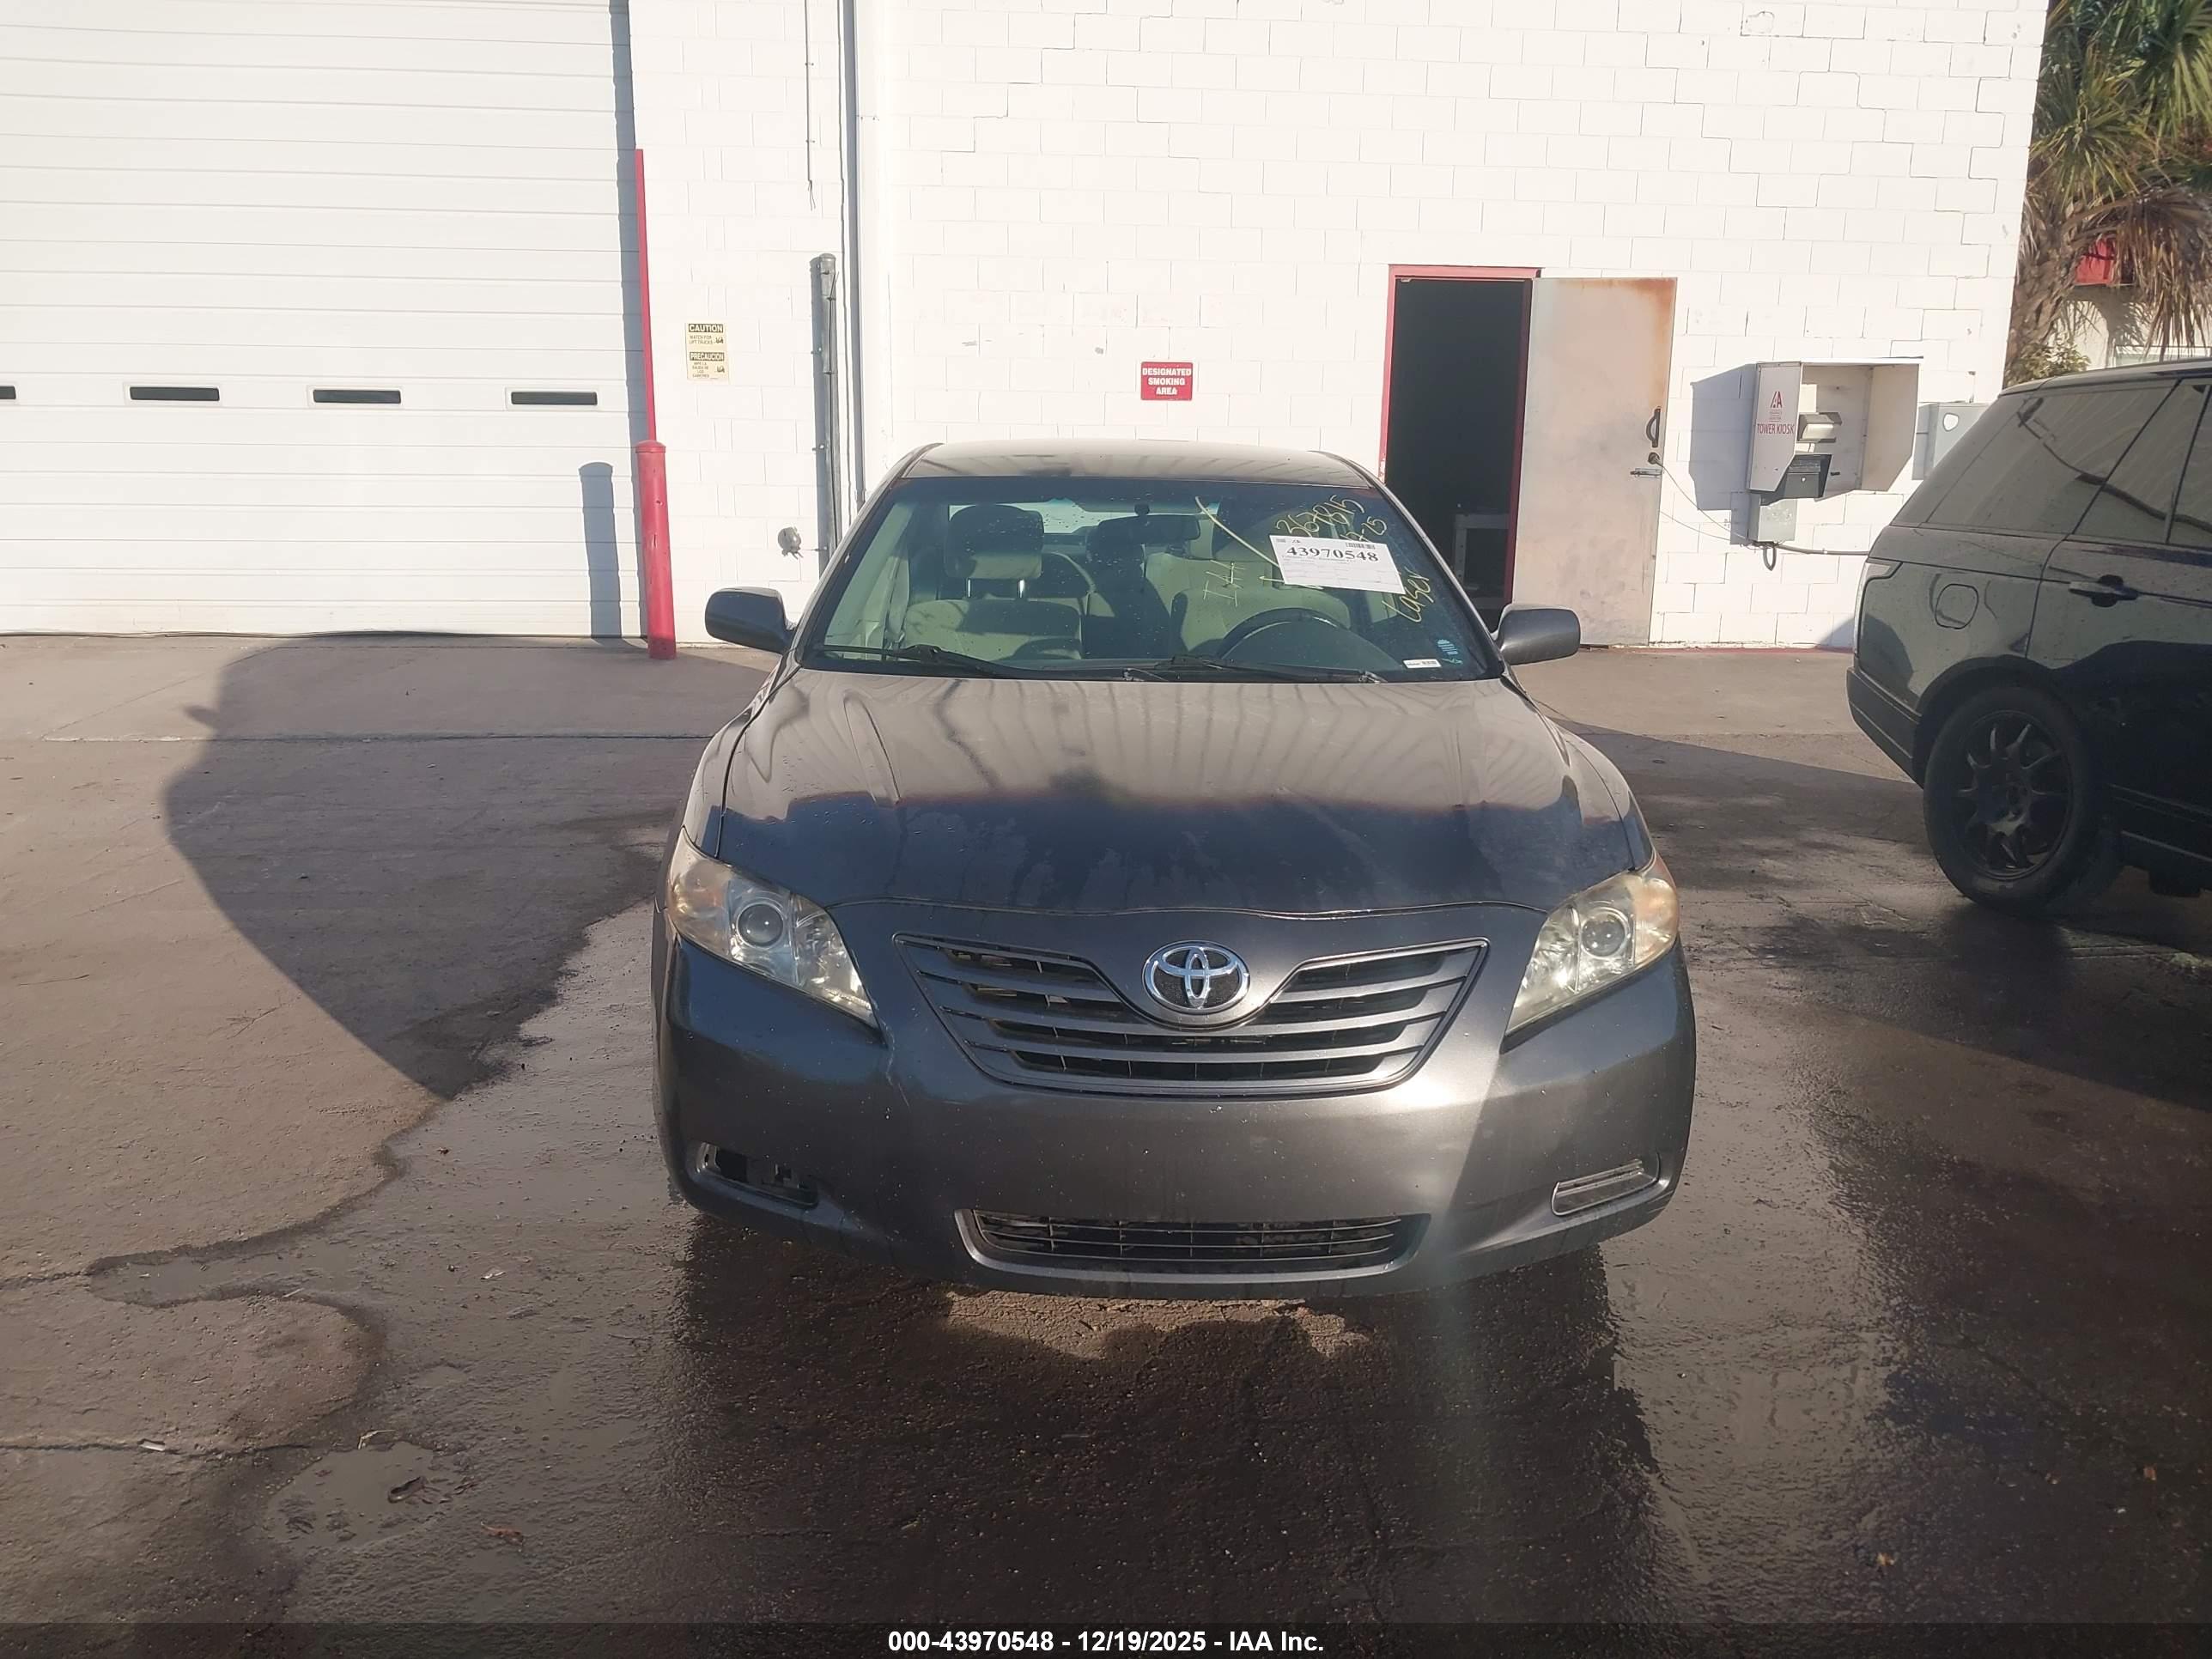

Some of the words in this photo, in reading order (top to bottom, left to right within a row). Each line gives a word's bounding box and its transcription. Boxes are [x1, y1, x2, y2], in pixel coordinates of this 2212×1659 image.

[689, 324, 723, 332] CAUTION
[690, 352, 724, 361] PRECAUCION
[1142, 368, 1192, 376] DESIGNATED
[1148, 377, 1185, 386] SMOKING
[1156, 386, 1177, 395] AREA
[1757, 423, 1776, 434] TOWER
[1776, 423, 1795, 434] KIOSK
[1286, 546, 1379, 562] 43970548
